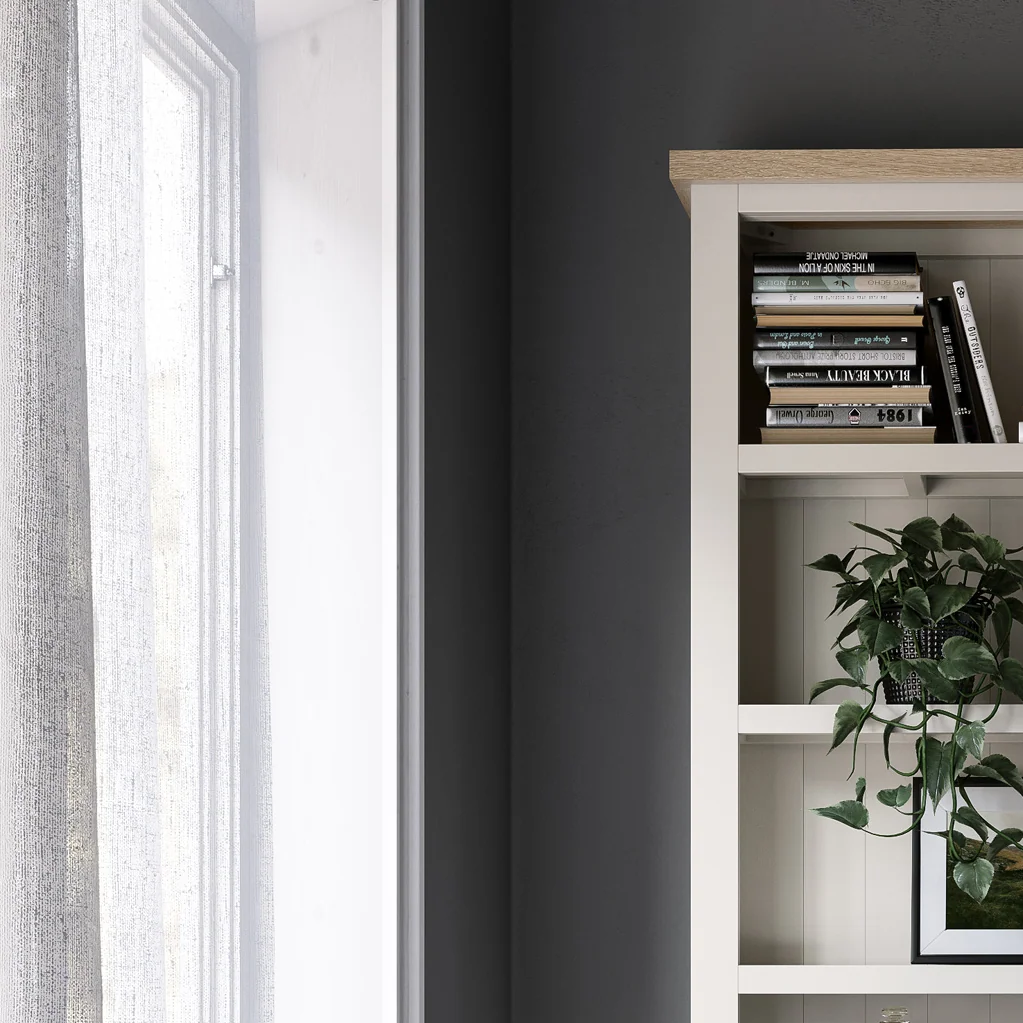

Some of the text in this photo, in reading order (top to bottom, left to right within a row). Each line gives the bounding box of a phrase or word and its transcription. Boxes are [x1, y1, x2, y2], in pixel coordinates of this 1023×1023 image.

[806, 252, 868, 260] MICHAEL ONDAATJE
[799, 263, 817, 273] LION
[824, 263, 834, 273] OF
[834, 263, 852, 273] SKIN
[853, 263, 868, 273] THE
[868, 263, 875, 273] IN
[967, 326, 985, 370] OUTSIDERS
[857, 352, 879, 361] SHORT
[880, 352, 905, 361] BRISTOL
[786, 371, 820, 379] Anna Sewell
[825, 369, 911, 382] BLACK BEAUTY
[776, 409, 803, 424] Orwell
[806, 408, 834, 424] George
[876, 408, 913, 423] 1984
